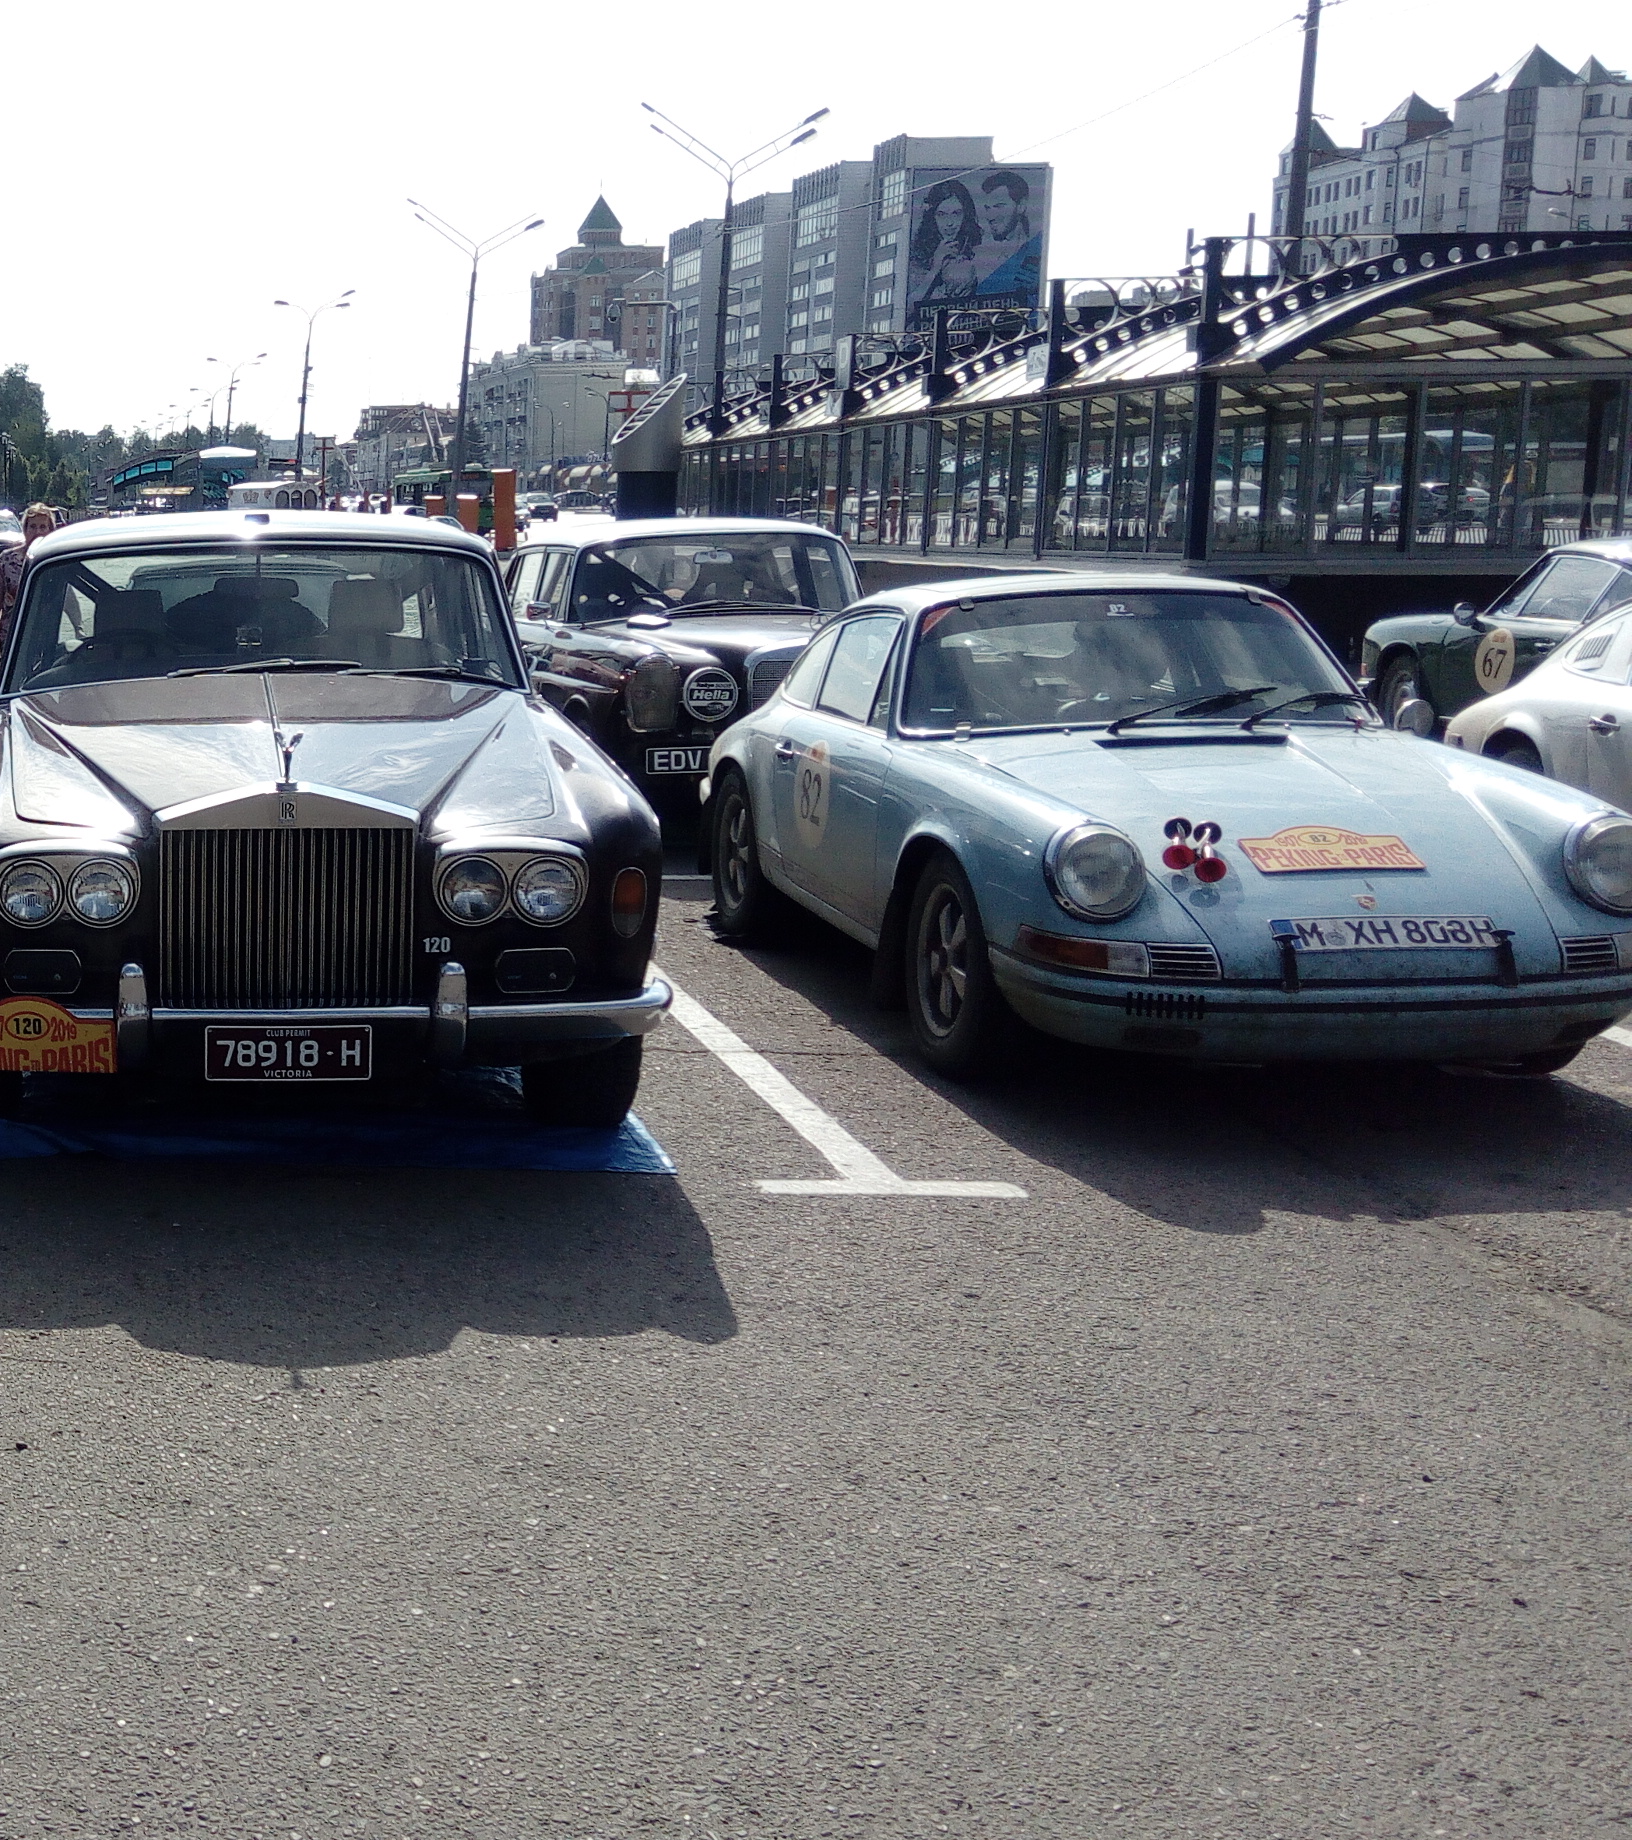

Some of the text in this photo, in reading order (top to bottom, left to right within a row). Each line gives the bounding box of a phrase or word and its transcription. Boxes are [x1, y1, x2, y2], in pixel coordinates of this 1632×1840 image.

[1482, 647, 1508, 679] 67
[692, 689, 730, 700] Hella
[653, 750, 702, 771] EDV
[800, 768, 822, 827] 82
[1275, 834, 1302, 847] 1907
[1309, 835, 1331, 843] 82
[1248, 846, 1342, 869] PEKING
[1343, 843, 1418, 866] PARIS
[1295, 922, 1326, 947] M
[1344, 919, 1399, 945] XH
[423, 937, 451, 953] 120
[13, 1018, 42, 1035] 120
[50, 1016, 77, 1042] 2019
[266, 1029, 311, 1037] CLUB PERMIT
[41, 1037, 110, 1074] PARIS
[264, 1069, 313, 1078] VICTORIA
